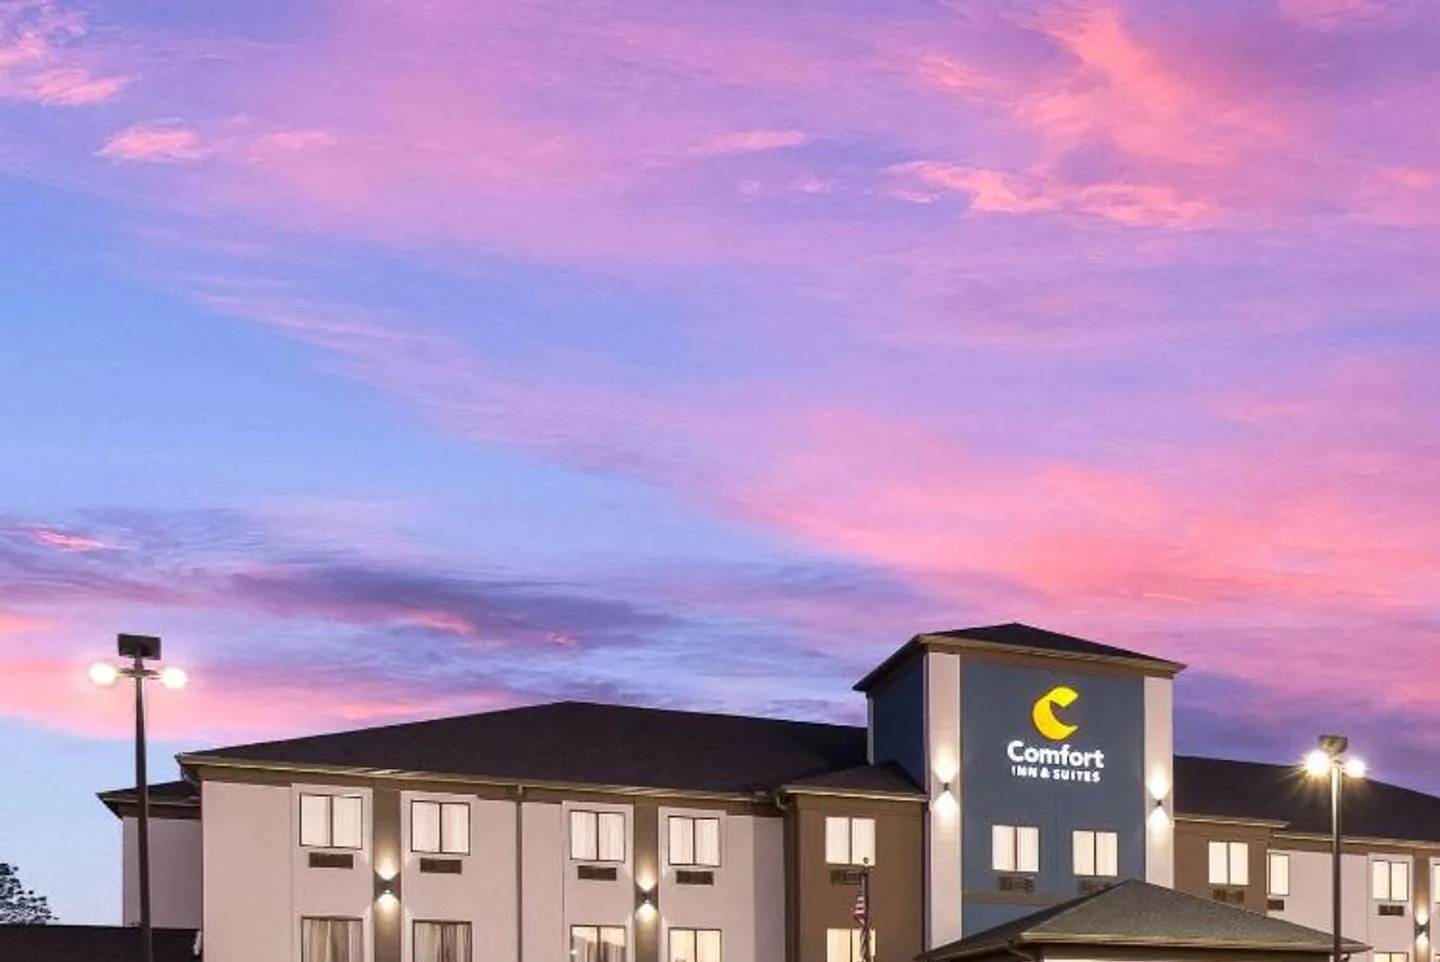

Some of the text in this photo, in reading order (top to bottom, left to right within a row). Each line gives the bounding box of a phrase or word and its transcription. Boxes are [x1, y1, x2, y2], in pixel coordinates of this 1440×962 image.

[1007, 740, 1105, 769] Comfort
[1011, 765, 1101, 783] INN & SUITES
